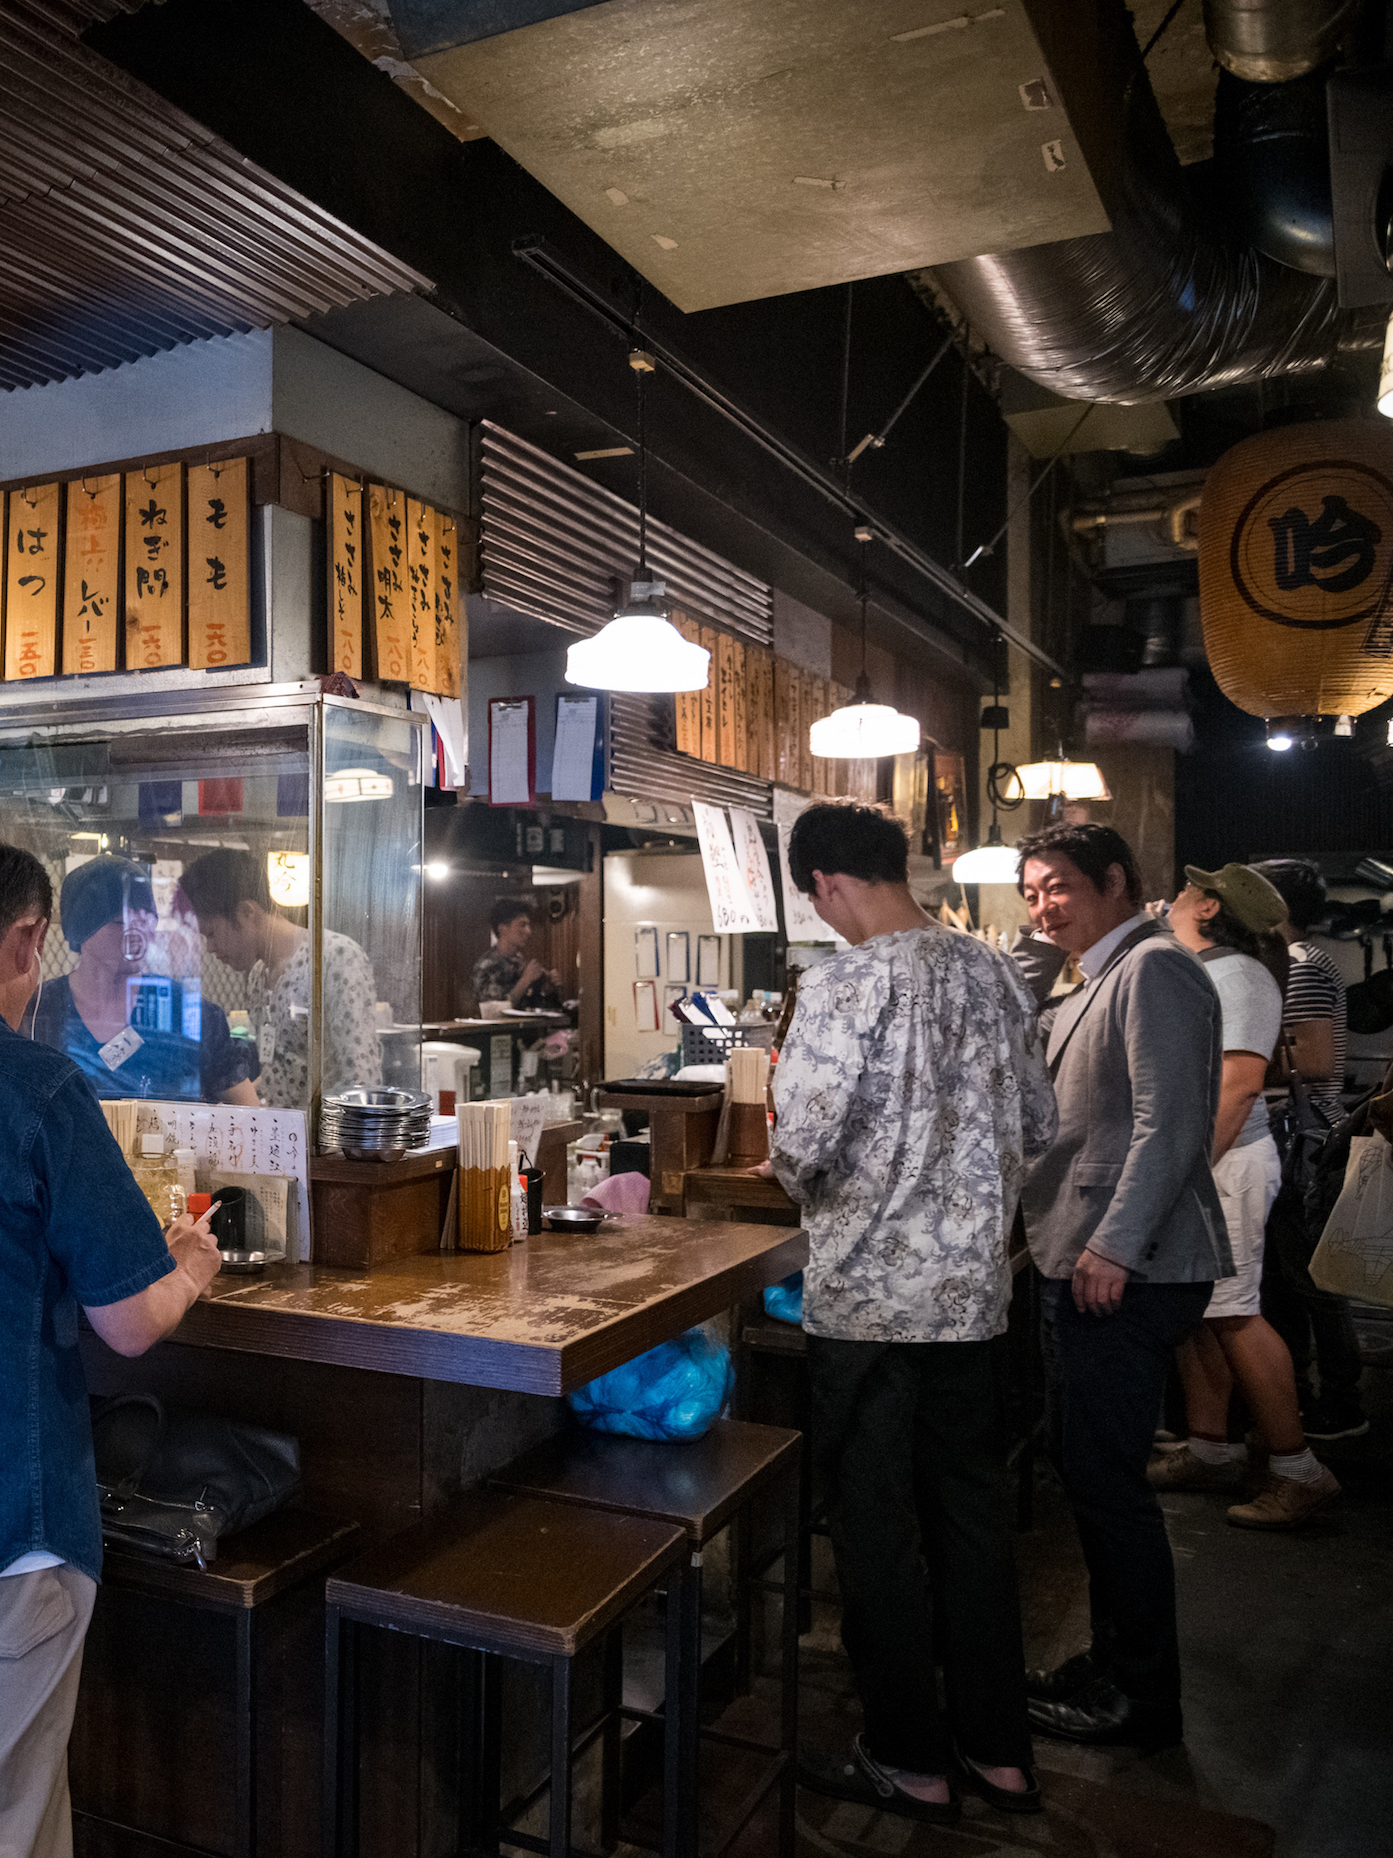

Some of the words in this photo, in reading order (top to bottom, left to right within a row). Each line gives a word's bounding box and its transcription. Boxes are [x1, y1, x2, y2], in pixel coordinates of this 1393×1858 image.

[17, 528, 48, 596] はつ
[77, 579, 109, 633] レバー
[377, 566, 394, 620] 明太
